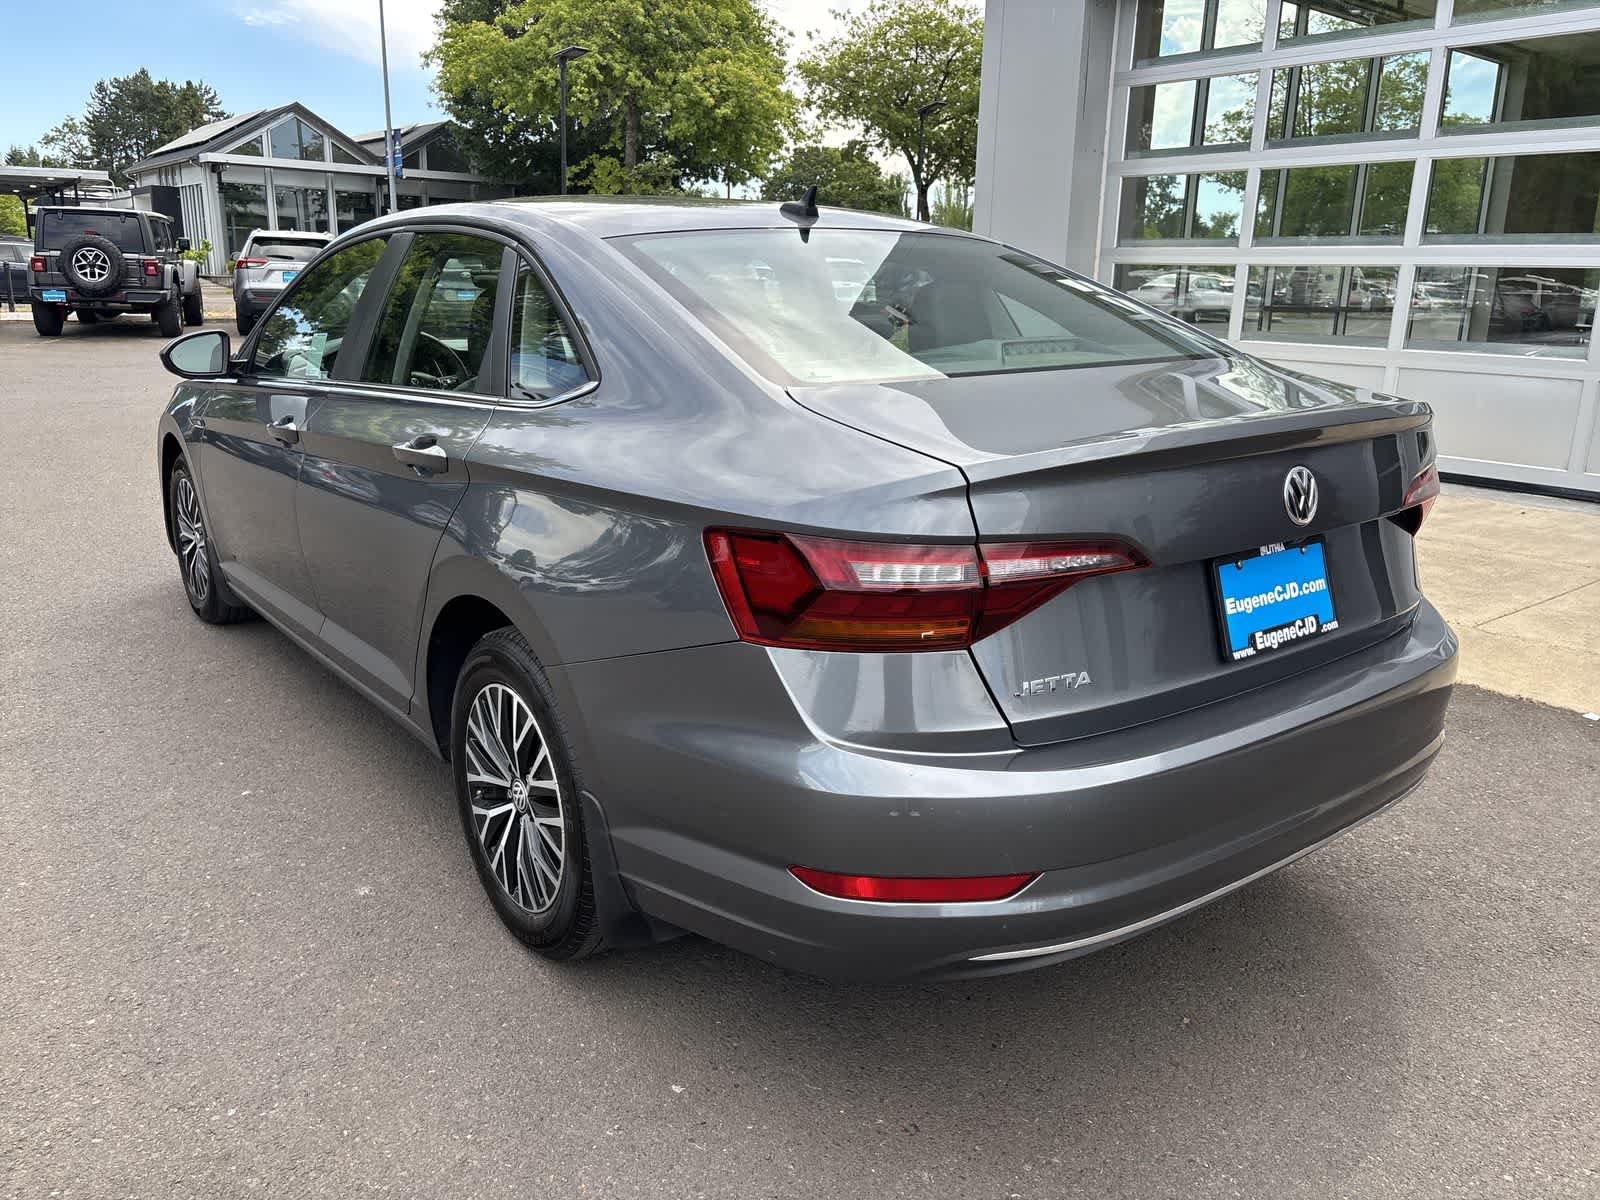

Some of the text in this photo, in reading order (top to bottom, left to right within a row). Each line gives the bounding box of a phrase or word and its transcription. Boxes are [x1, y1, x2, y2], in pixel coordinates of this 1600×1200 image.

[1225, 577, 1326, 614] EugeneCJD.com
[1232, 646, 1256, 660] www.
[1255, 615, 1317, 649] EugeneCJD
[1013, 672, 1091, 696] JETTA
